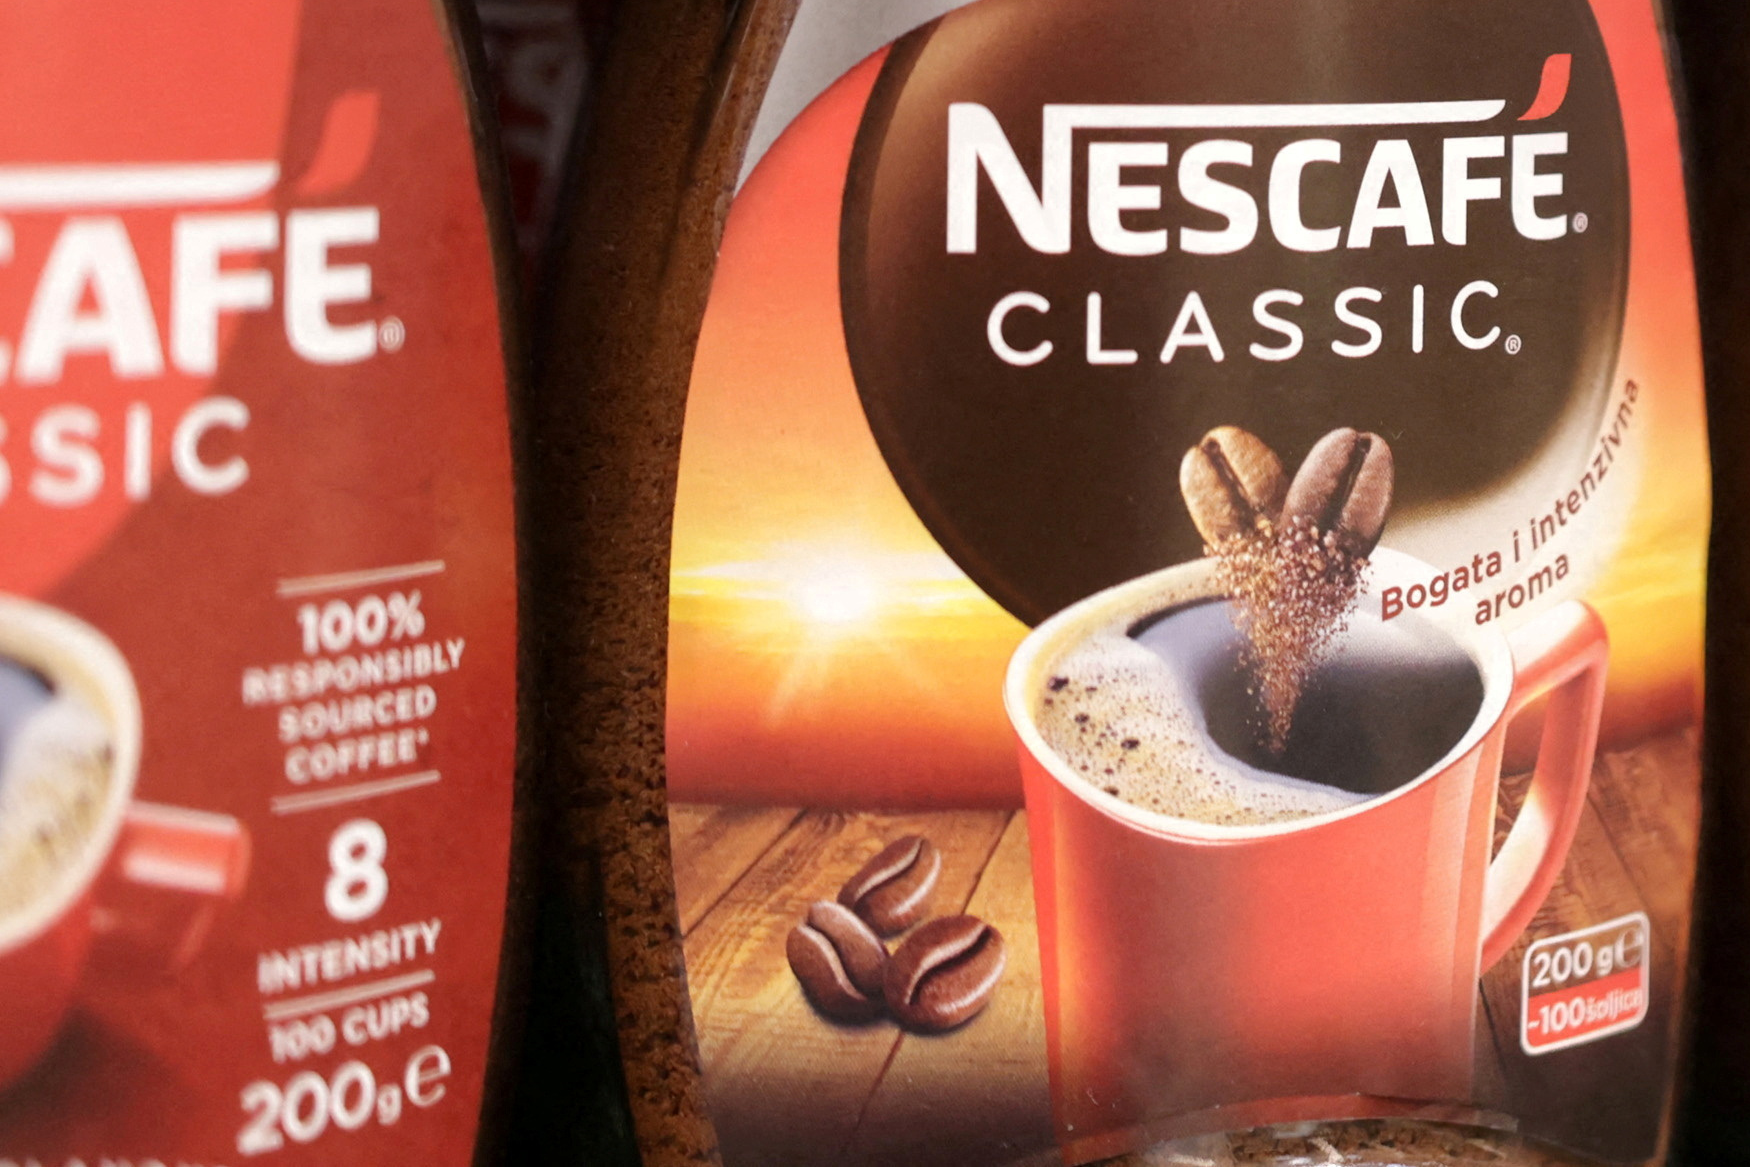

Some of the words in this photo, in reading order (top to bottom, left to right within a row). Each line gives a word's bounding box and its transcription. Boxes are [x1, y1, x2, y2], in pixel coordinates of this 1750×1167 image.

[986, 280, 1502, 367] CLASSIC
[0, 394, 251, 509] SIC
[1380, 550, 1502, 622] Bogata
[1511, 529, 1522, 564] i
[1530, 378, 1640, 552] intenzivna
[297, 587, 426, 657] 100%
[1474, 552, 1570, 626] aroma
[241, 636, 466, 708] RESPONSIBLY
[277, 683, 437, 744] SOURCED
[323, 817, 390, 923] 8
[257, 917, 442, 994] INTENSITY
[268, 1014, 337, 1064] 100
[342, 991, 430, 1047] CUPS
